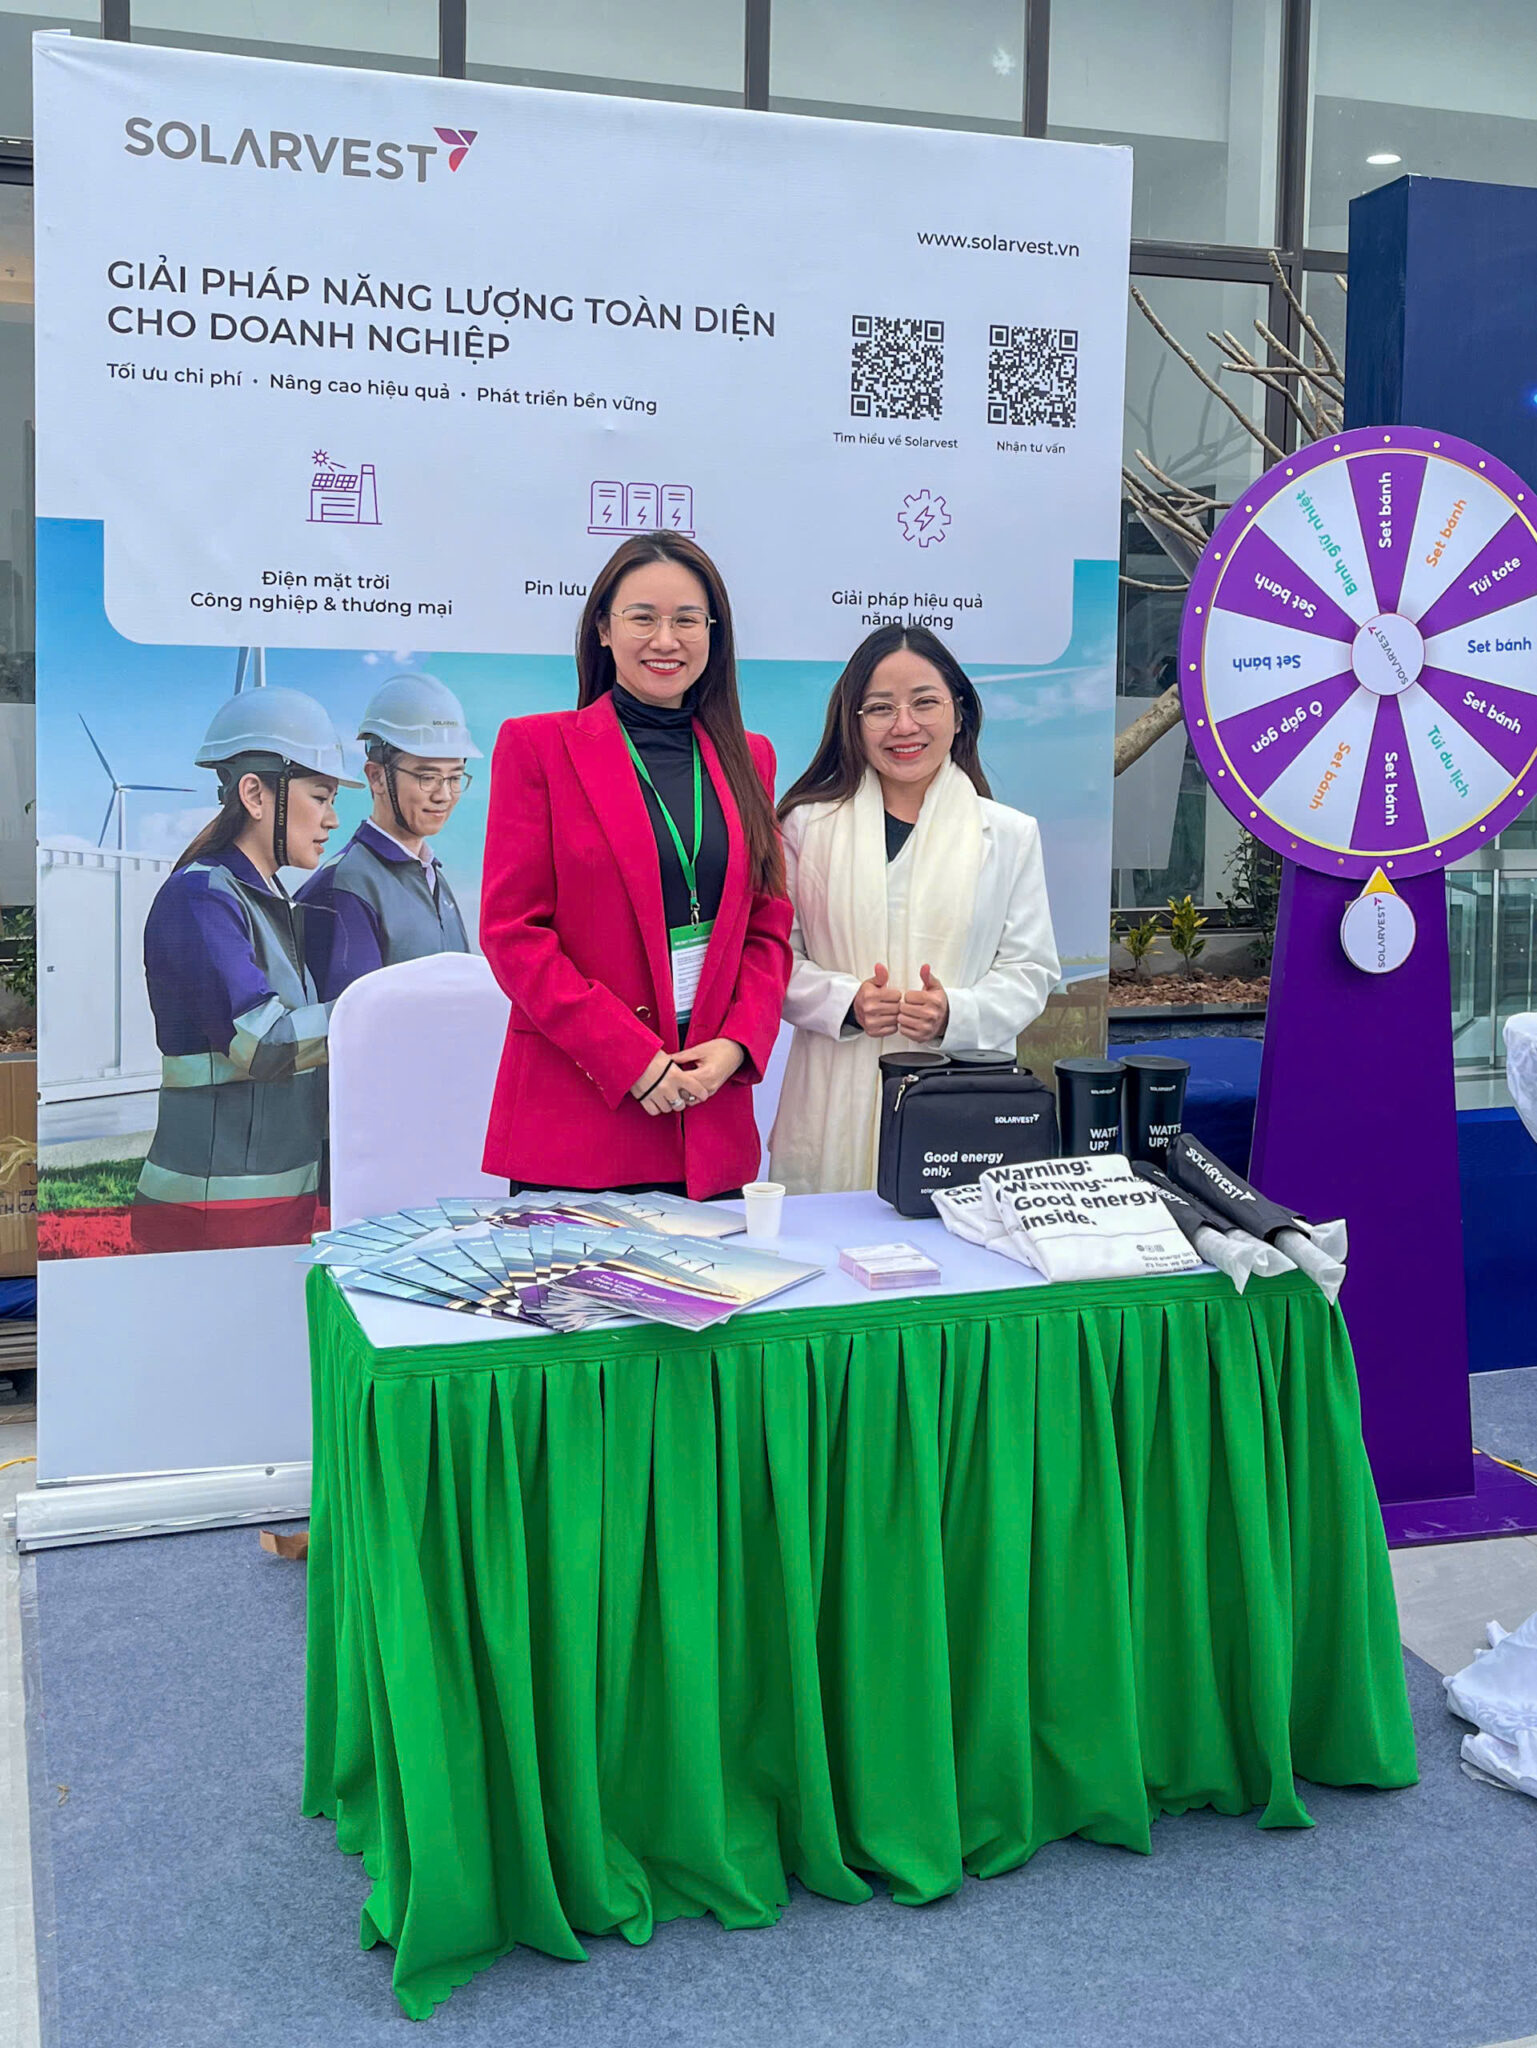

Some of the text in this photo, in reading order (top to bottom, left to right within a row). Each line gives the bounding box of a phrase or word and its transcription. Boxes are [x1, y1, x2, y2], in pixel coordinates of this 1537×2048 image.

[124, 117, 438, 183] SOLARVEST
[917, 232, 1080, 257] www.solarvest.vn
[107, 254, 775, 342] GIẢI PHÁP NĂNG LƯỢNG TOÀN DIỆN
[107, 305, 510, 365] CHO DOANH NGHIỆP
[107, 362, 657, 415] Tối ưu chi phí Nâng cao hiệu quả Phát triển bền vững
[905, 436, 958, 449] Solarvest
[997, 441, 1066, 454] Nhận tư vấn
[1378, 472, 1392, 549] Set bánh
[1296, 489, 1358, 597] Bình giữ nhiệt
[1425, 498, 1468, 568] Set bánh
[261, 570, 390, 590] Điện mặt trời
[524, 580, 588, 597] Pin lưu
[1468, 556, 1522, 597] Túi tote
[191, 592, 453, 619] Công nghiệp & thương mại
[832, 590, 983, 611] Giải pháp hiệu quả
[1254, 572, 1318, 619] Set bánh
[862, 612, 902, 626] năng
[1374, 629, 1409, 686] SOLARVEST
[1467, 636, 1532, 654] Set bánh
[1232, 654, 1302, 672] Set bánh
[1280, 706, 1307, 733] gấp
[1462, 690, 1522, 735] Set bánh
[1251, 726, 1279, 753] gọn
[1426, 724, 1470, 799] Túi du lịch
[1308, 742, 1351, 811] Set bánh
[1384, 752, 1399, 826] Set bánh
[1377, 905, 1386, 969] SOLARVEST
[995, 1115, 1033, 1124] SOLARVEST
[1089, 1140, 1110, 1151] UP?
[1148, 1137, 1169, 1147] UP?
[924, 1151, 1003, 1164] Good energy
[922, 1165, 951, 1178] only.
[985, 1160, 1093, 1184] Warning:
[1185, 1147, 1242, 1199] SOLARVEST
[1003, 1179, 1107, 1194] Warning:
[1014, 1193, 1077, 1211] Good
[1080, 1191, 1158, 1209] energy
[1021, 1209, 1097, 1231] inside.
